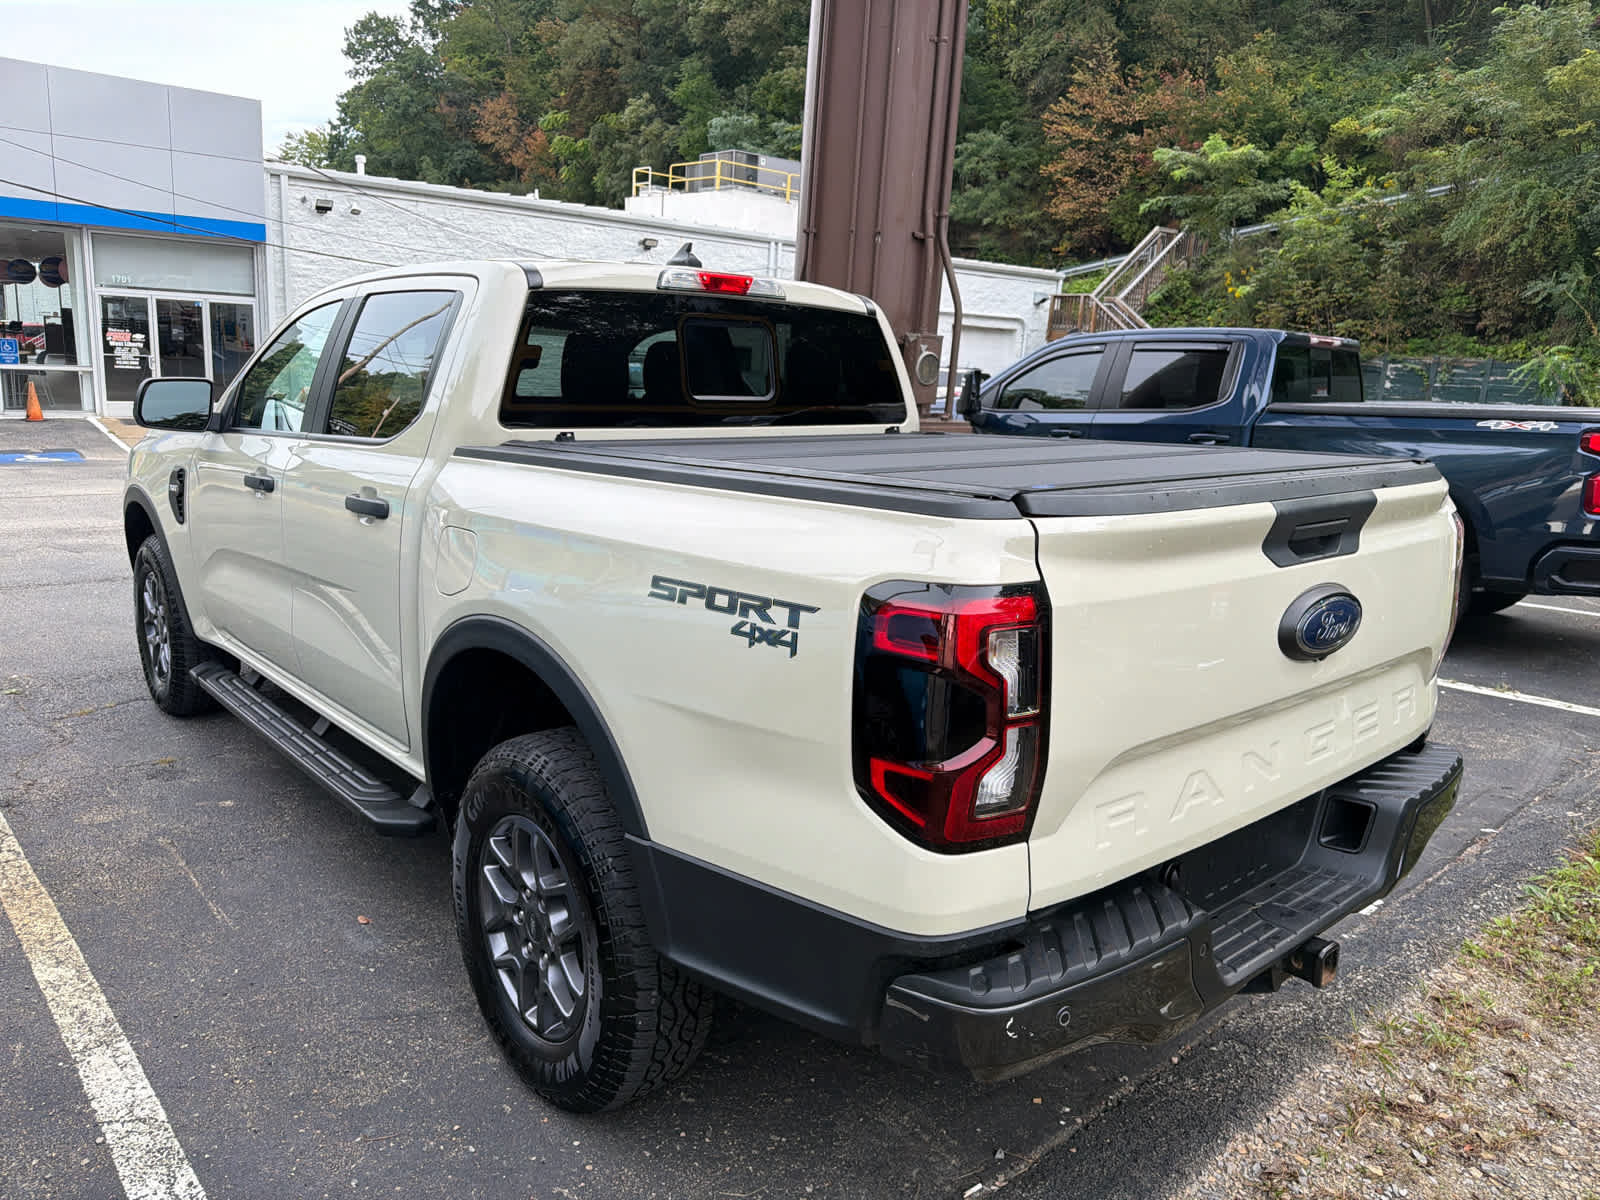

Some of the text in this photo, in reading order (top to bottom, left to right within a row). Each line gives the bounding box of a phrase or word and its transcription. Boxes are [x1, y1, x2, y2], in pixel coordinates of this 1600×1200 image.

[648, 575, 821, 629] SPORT
[731, 620, 798, 659] 4x4
[1316, 610, 1352, 642] Ford
[1095, 683, 1417, 850] RANGER
